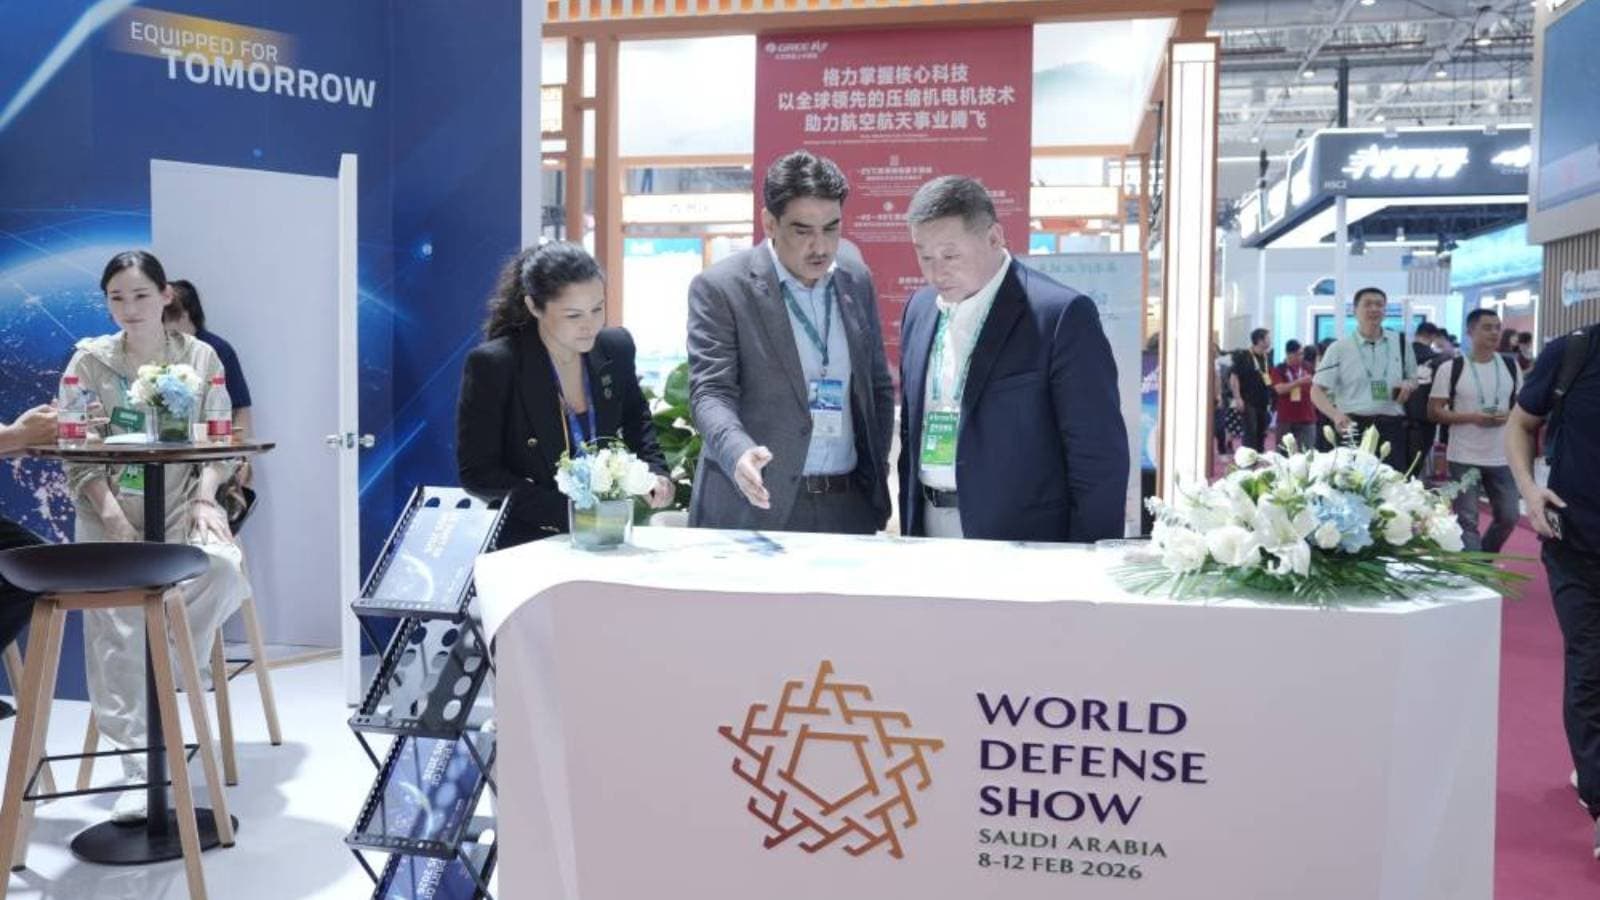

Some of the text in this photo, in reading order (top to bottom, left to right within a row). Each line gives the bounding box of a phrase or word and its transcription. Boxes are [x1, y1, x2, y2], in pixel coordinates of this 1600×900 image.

[131, 21, 279, 63] EQUIPPED FOR
[160, 47, 376, 108] TOMORROW
[822, 63, 969, 87] 格力掌握核心科技
[778, 86, 1016, 111] 以全球领先的压缩机电机技术
[804, 109, 988, 133] 助力航空航天事业腾飞
[976, 692, 1188, 735] WORLD
[979, 738, 1208, 784] DEFENSE
[978, 785, 1142, 826] SHOW
[978, 828, 1168, 858] SAUDI ARABIA
[978, 852, 1143, 880] 8-12 FEB 2026
